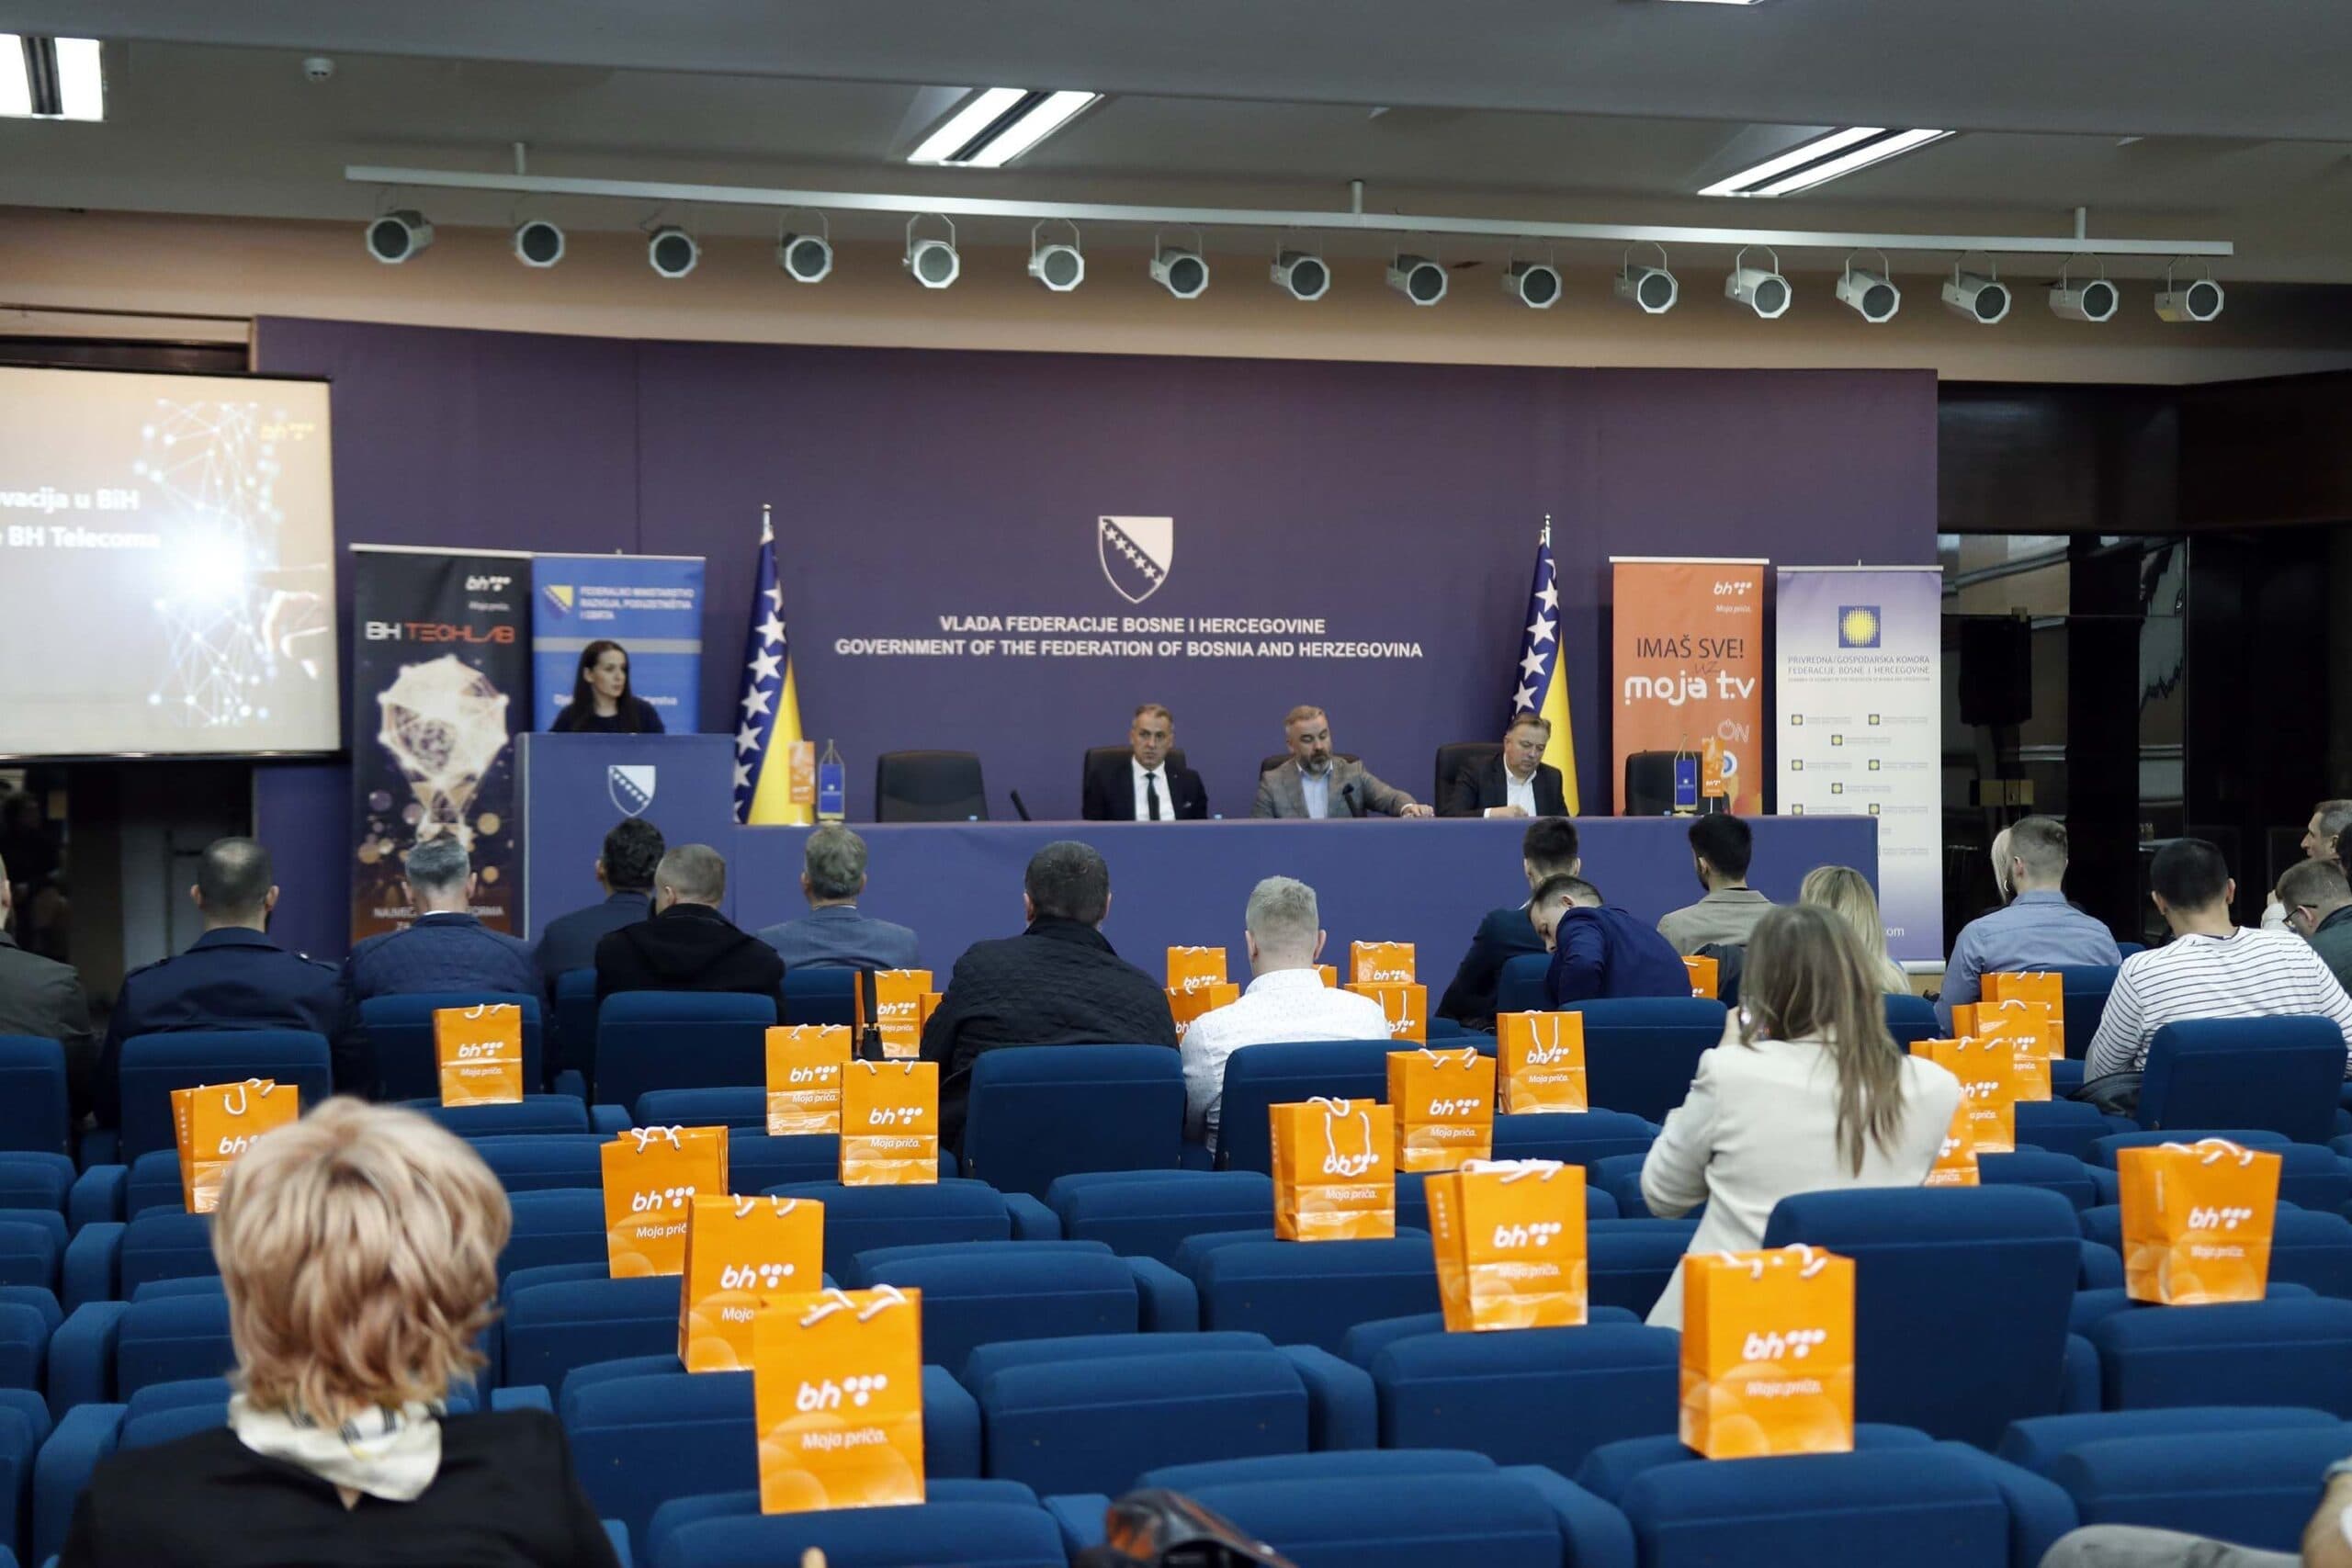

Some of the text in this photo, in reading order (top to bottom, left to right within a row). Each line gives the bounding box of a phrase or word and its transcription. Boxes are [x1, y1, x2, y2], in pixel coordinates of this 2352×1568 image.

[74, 493, 90, 509] u
[8, 526, 44, 547] BH
[366, 621, 515, 643] BH TECHLAB
[940, 615, 1325, 634] VLADA FEDERACIJE BOSNE I HERCEGOVINE
[835, 638, 1423, 658] GOVERNMENT OF THE FEDERATION OF BOSNIA AND HERZEGOVINA
[1637, 634, 1744, 660] IMAŠ SVE!
[1896, 656, 1930, 664] KOMORA
[1624, 671, 1707, 705] moja
[1176, 1021, 1190, 1033] bh
[219, 1136, 246, 1155] bh
[870, 1137, 894, 1148] Moja
[636, 1222, 686, 1239] Moja prič
[801, 1433, 842, 1451] Moja
